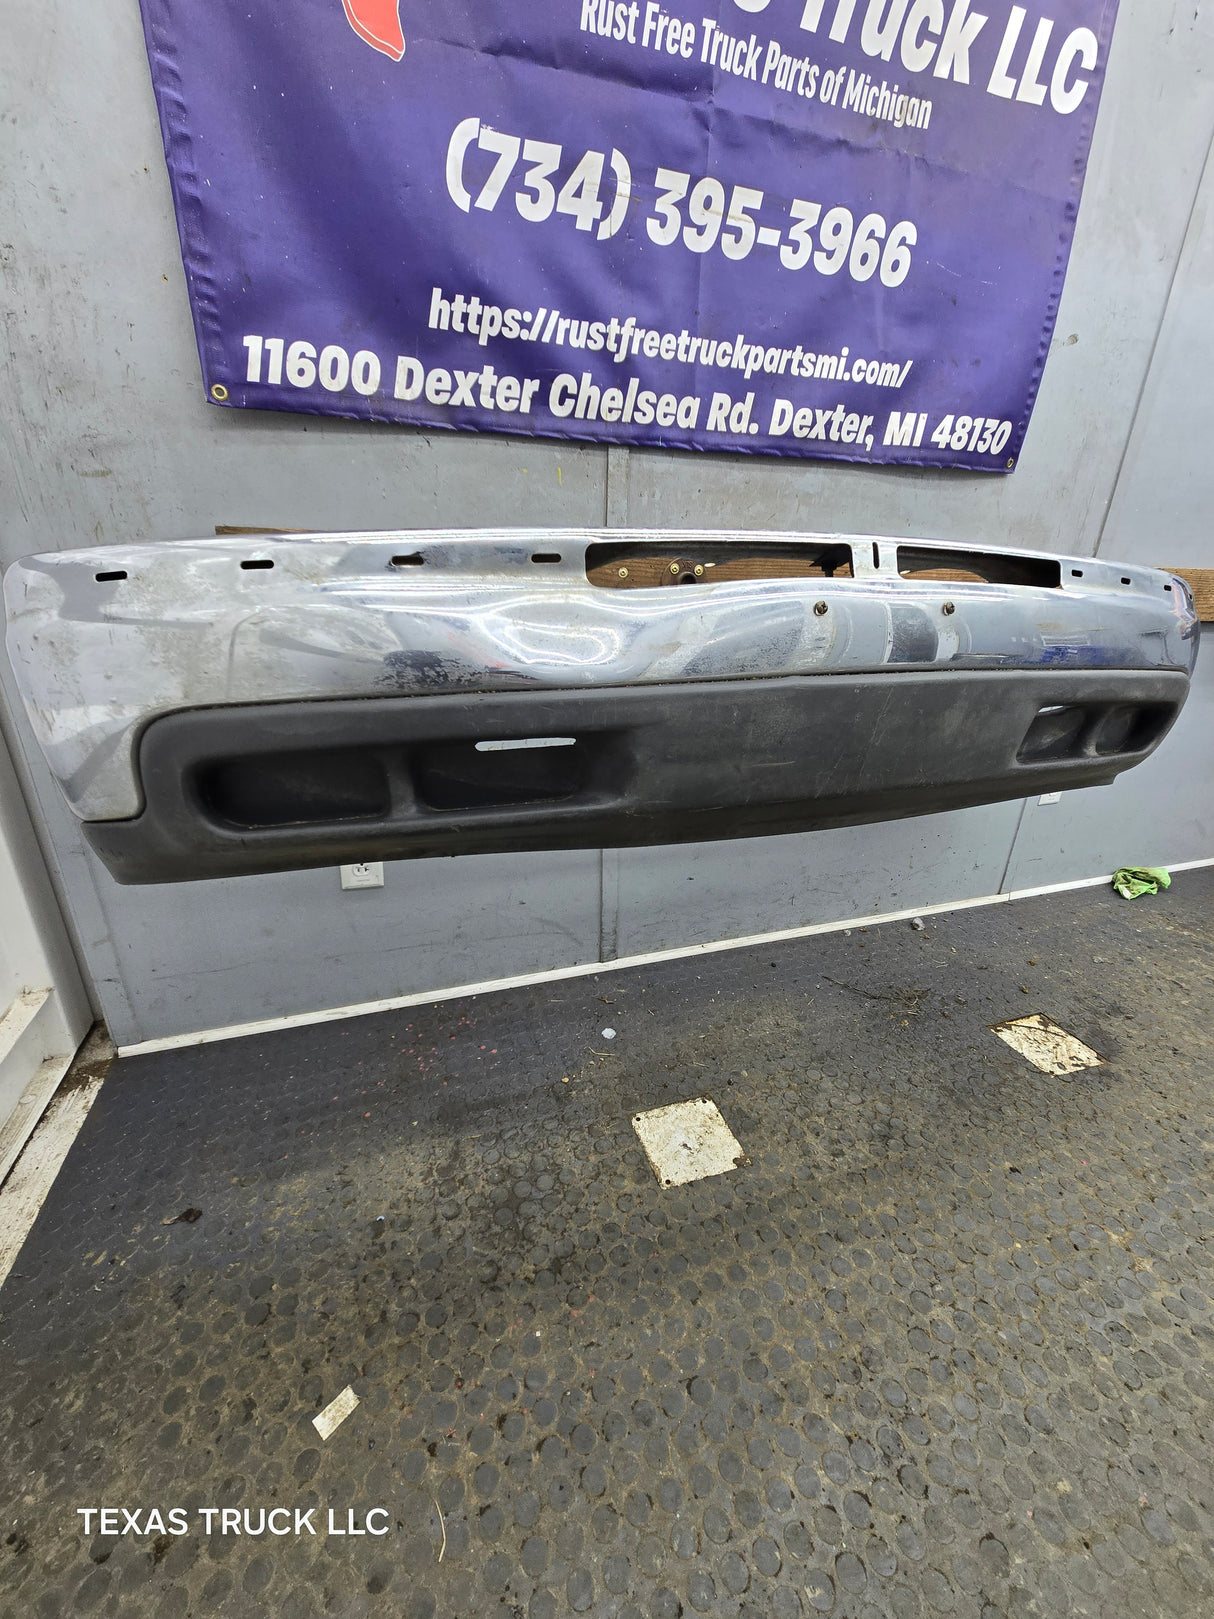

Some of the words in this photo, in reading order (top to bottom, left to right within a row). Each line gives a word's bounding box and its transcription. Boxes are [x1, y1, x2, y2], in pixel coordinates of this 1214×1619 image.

[580, 0, 640, 44] Rust
[641, 1, 696, 59] Free
[700, 17, 764, 81] Truck
[761, 40, 820, 99] Parts
[820, 66, 847, 106] of
[842, 69, 932, 130] Michigan
[986, 4, 1099, 115] LLC
[445, 117, 632, 240] (734)
[646, 167, 917, 288] 395-3966
[243, 334, 381, 396] 11600
[394, 355, 540, 413] Dexter
[549, 373, 700, 429] Chelsea
[706, 391, 759, 435] Rd.
[768, 398, 875, 452] Dexter,
[883, 410, 928, 447] MI
[931, 414, 1013, 455] 48130
[429, 287, 913, 389] https://rustfreetruckpartsmi.com/
